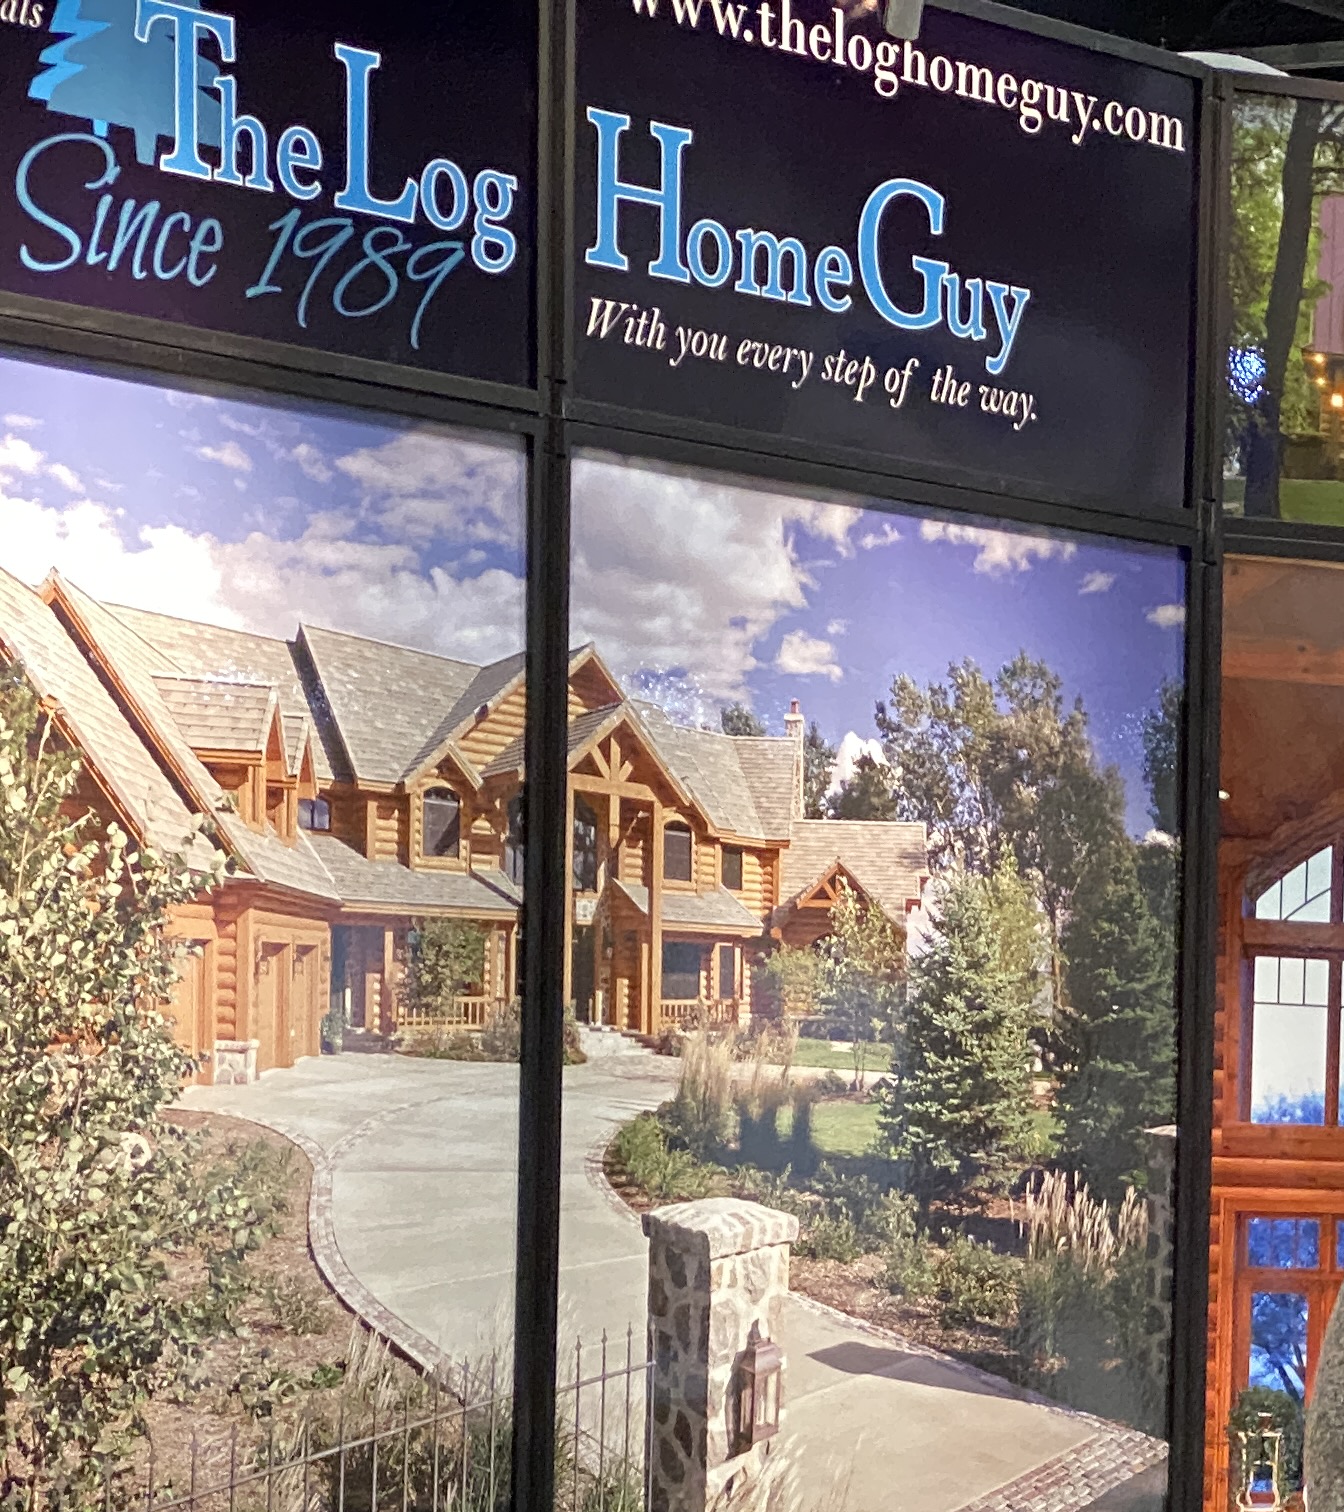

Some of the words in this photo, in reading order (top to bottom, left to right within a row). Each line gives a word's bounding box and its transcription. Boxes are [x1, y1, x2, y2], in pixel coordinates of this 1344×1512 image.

[15, 131, 224, 288] Since
[245, 207, 467, 350] 1989
[133, 0, 324, 201] The
[333, 41, 519, 274] Log
[584, 105, 854, 315] Home
[857, 176, 1031, 376] Guy
[585, 296, 667, 351] With
[669, 324, 728, 367] you
[736, 336, 815, 389] every
[820, 346, 877, 404] step
[882, 357, 920, 410] of
[930, 364, 971, 409] the
[977, 383, 1038, 431] way.
